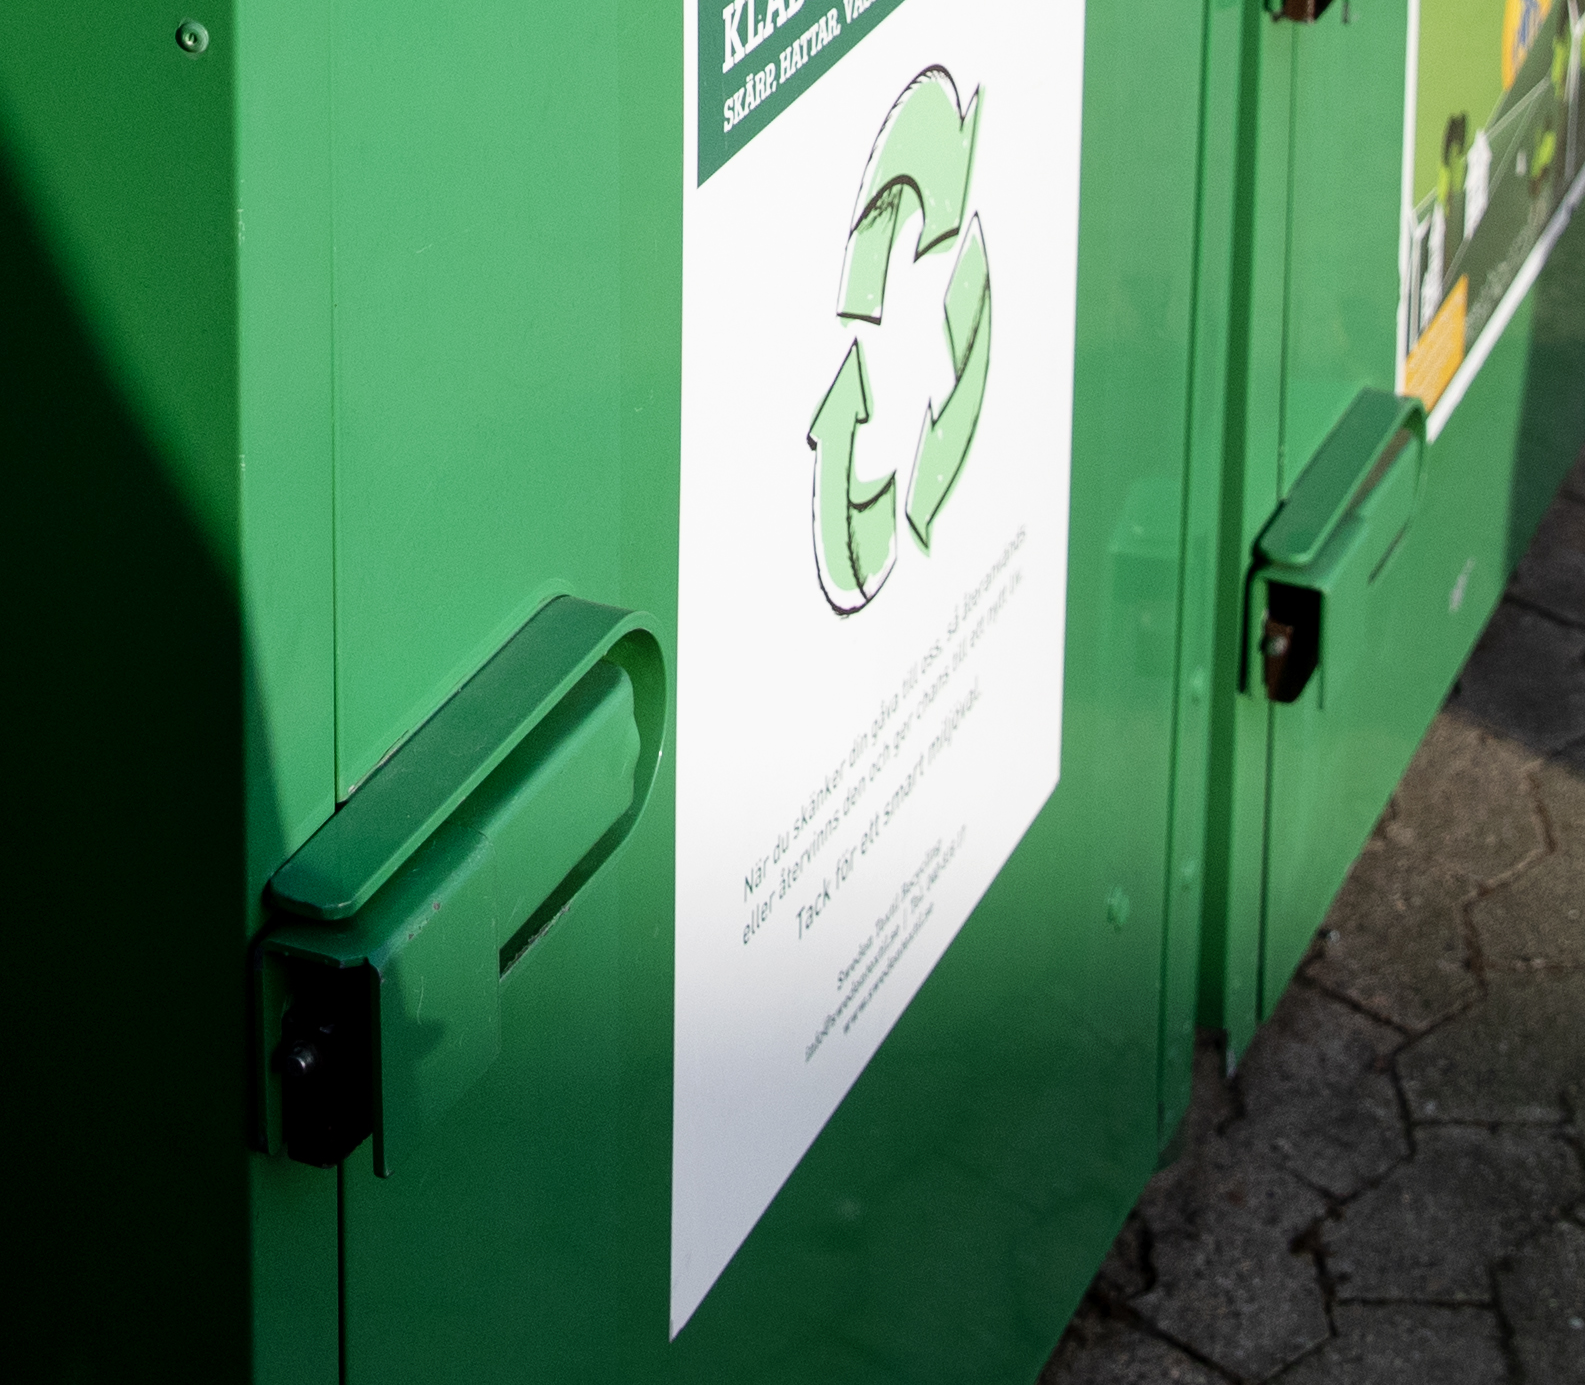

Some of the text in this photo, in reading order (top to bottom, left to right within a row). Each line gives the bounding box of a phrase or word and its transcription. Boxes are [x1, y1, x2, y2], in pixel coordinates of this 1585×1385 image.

[743, 890, 775, 944] eller
[779, 815, 839, 900] återvinns
[843, 775, 866, 816] den
[869, 743, 890, 782] och
[744, 856, 769, 902] När
[773, 831, 789, 864] du
[793, 760, 845, 839] skänker
[849, 732, 868, 768] din
[796, 877, 831, 940] Tack
[835, 845, 857, 890] för
[860, 812, 879, 855] ett
[883, 753, 924, 827] smart
